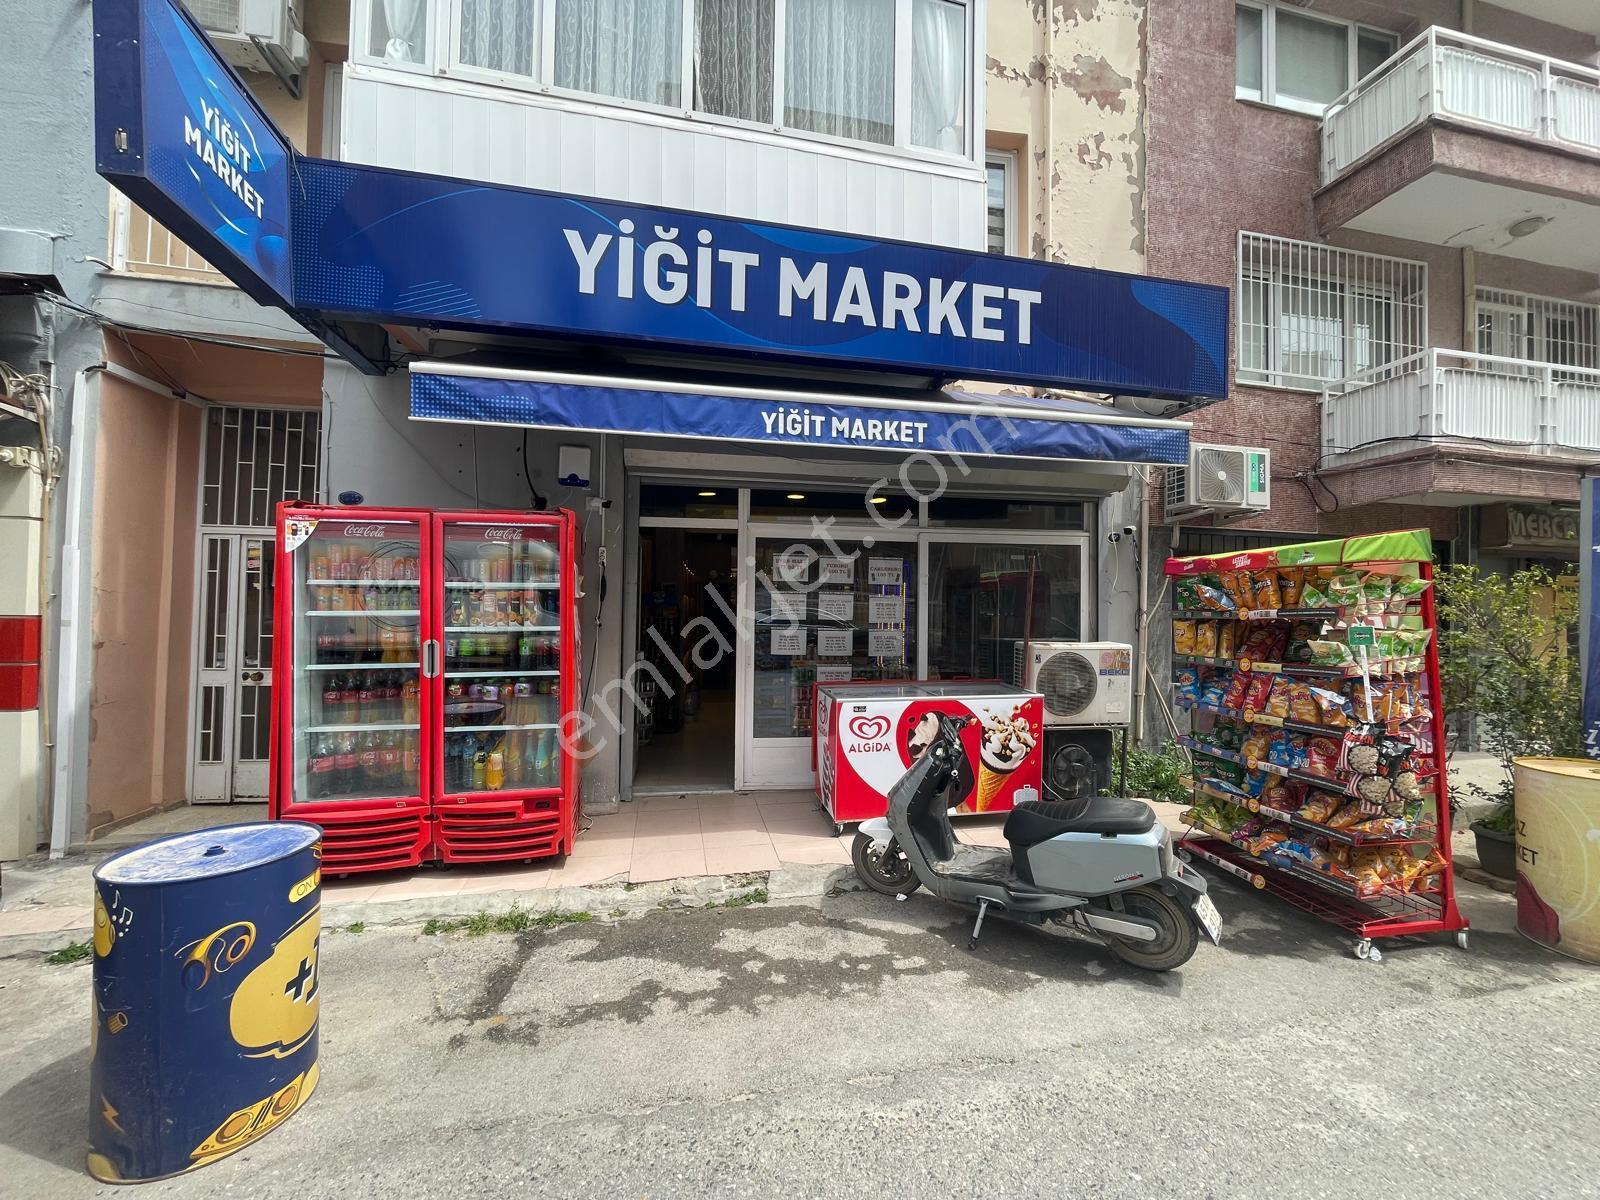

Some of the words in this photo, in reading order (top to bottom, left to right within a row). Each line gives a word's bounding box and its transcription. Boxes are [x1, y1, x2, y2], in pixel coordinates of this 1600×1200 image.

[184, 115, 265, 220] MARKET
[200, 96, 251, 174] YİĞİT
[563, 218, 762, 312] YİĞİT
[778, 256, 1042, 346] MARKET
[761, 407, 826, 437] YİĞİT
[832, 416, 929, 444] MARKET
